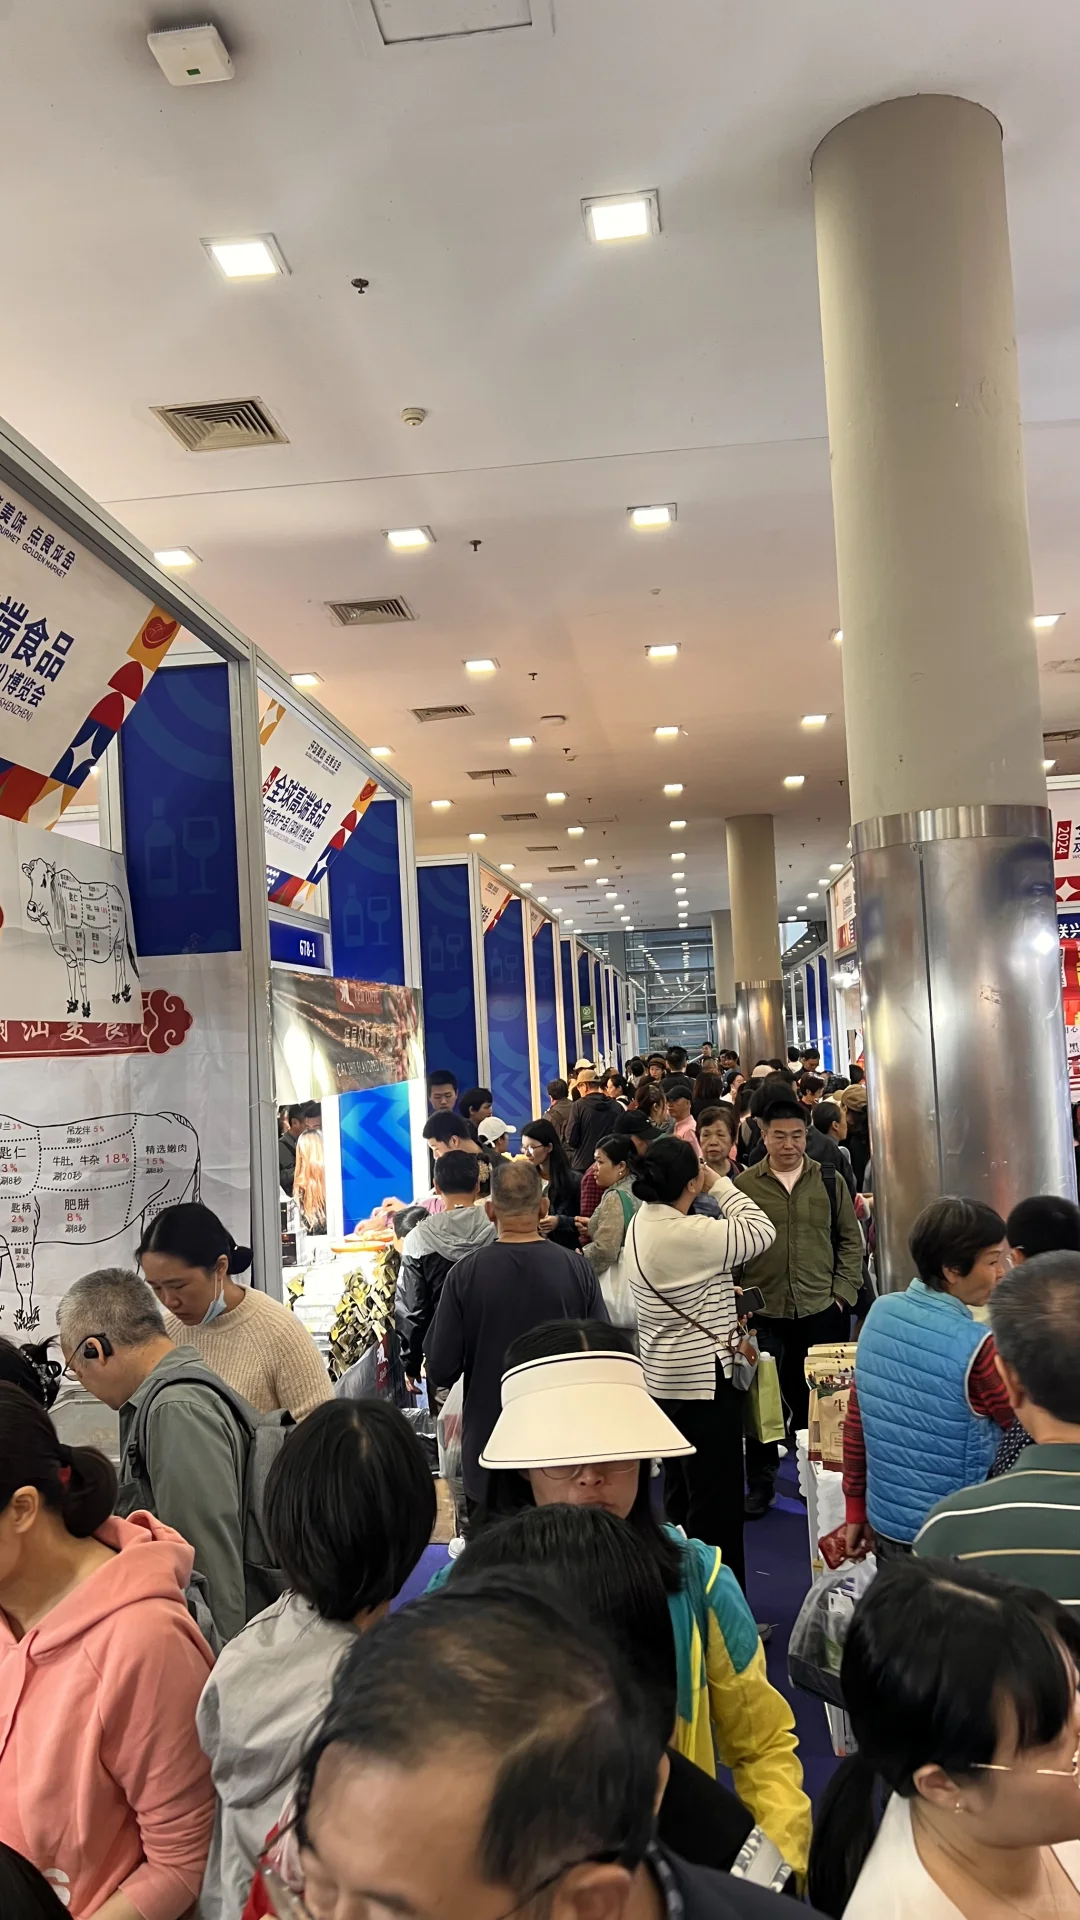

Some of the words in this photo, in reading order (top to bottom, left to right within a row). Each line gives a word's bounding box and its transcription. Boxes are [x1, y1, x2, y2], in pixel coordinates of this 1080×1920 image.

[0, 496, 27, 534] 美味
[27, 525, 76, 570] 点食成金
[22, 543, 46, 564] GOLDEN
[45, 560, 67, 578] MARKET
[266, 773, 332, 829] 全球高端食品
[1057, 826, 1070, 854] 2024
[299, 939, 316, 958] 678-1
[67, 1126, 91, 1135] 吊龙伴
[0, 1146, 26, 1159] 匙仁
[145, 1144, 187, 1154] 精选嫩肉
[105, 1153, 130, 1164] 18%
[146, 1157, 165, 1165] 15%
[1, 1163, 18, 1173] 3%
[0, 1176, 22, 1185] 涮8秒
[52, 1171, 83, 1181] 涮20秒
[11, 1202, 31, 1213] 匙柄
[67, 1213, 83, 1222] 8%
[65, 1224, 87, 1233] 涮8秒
